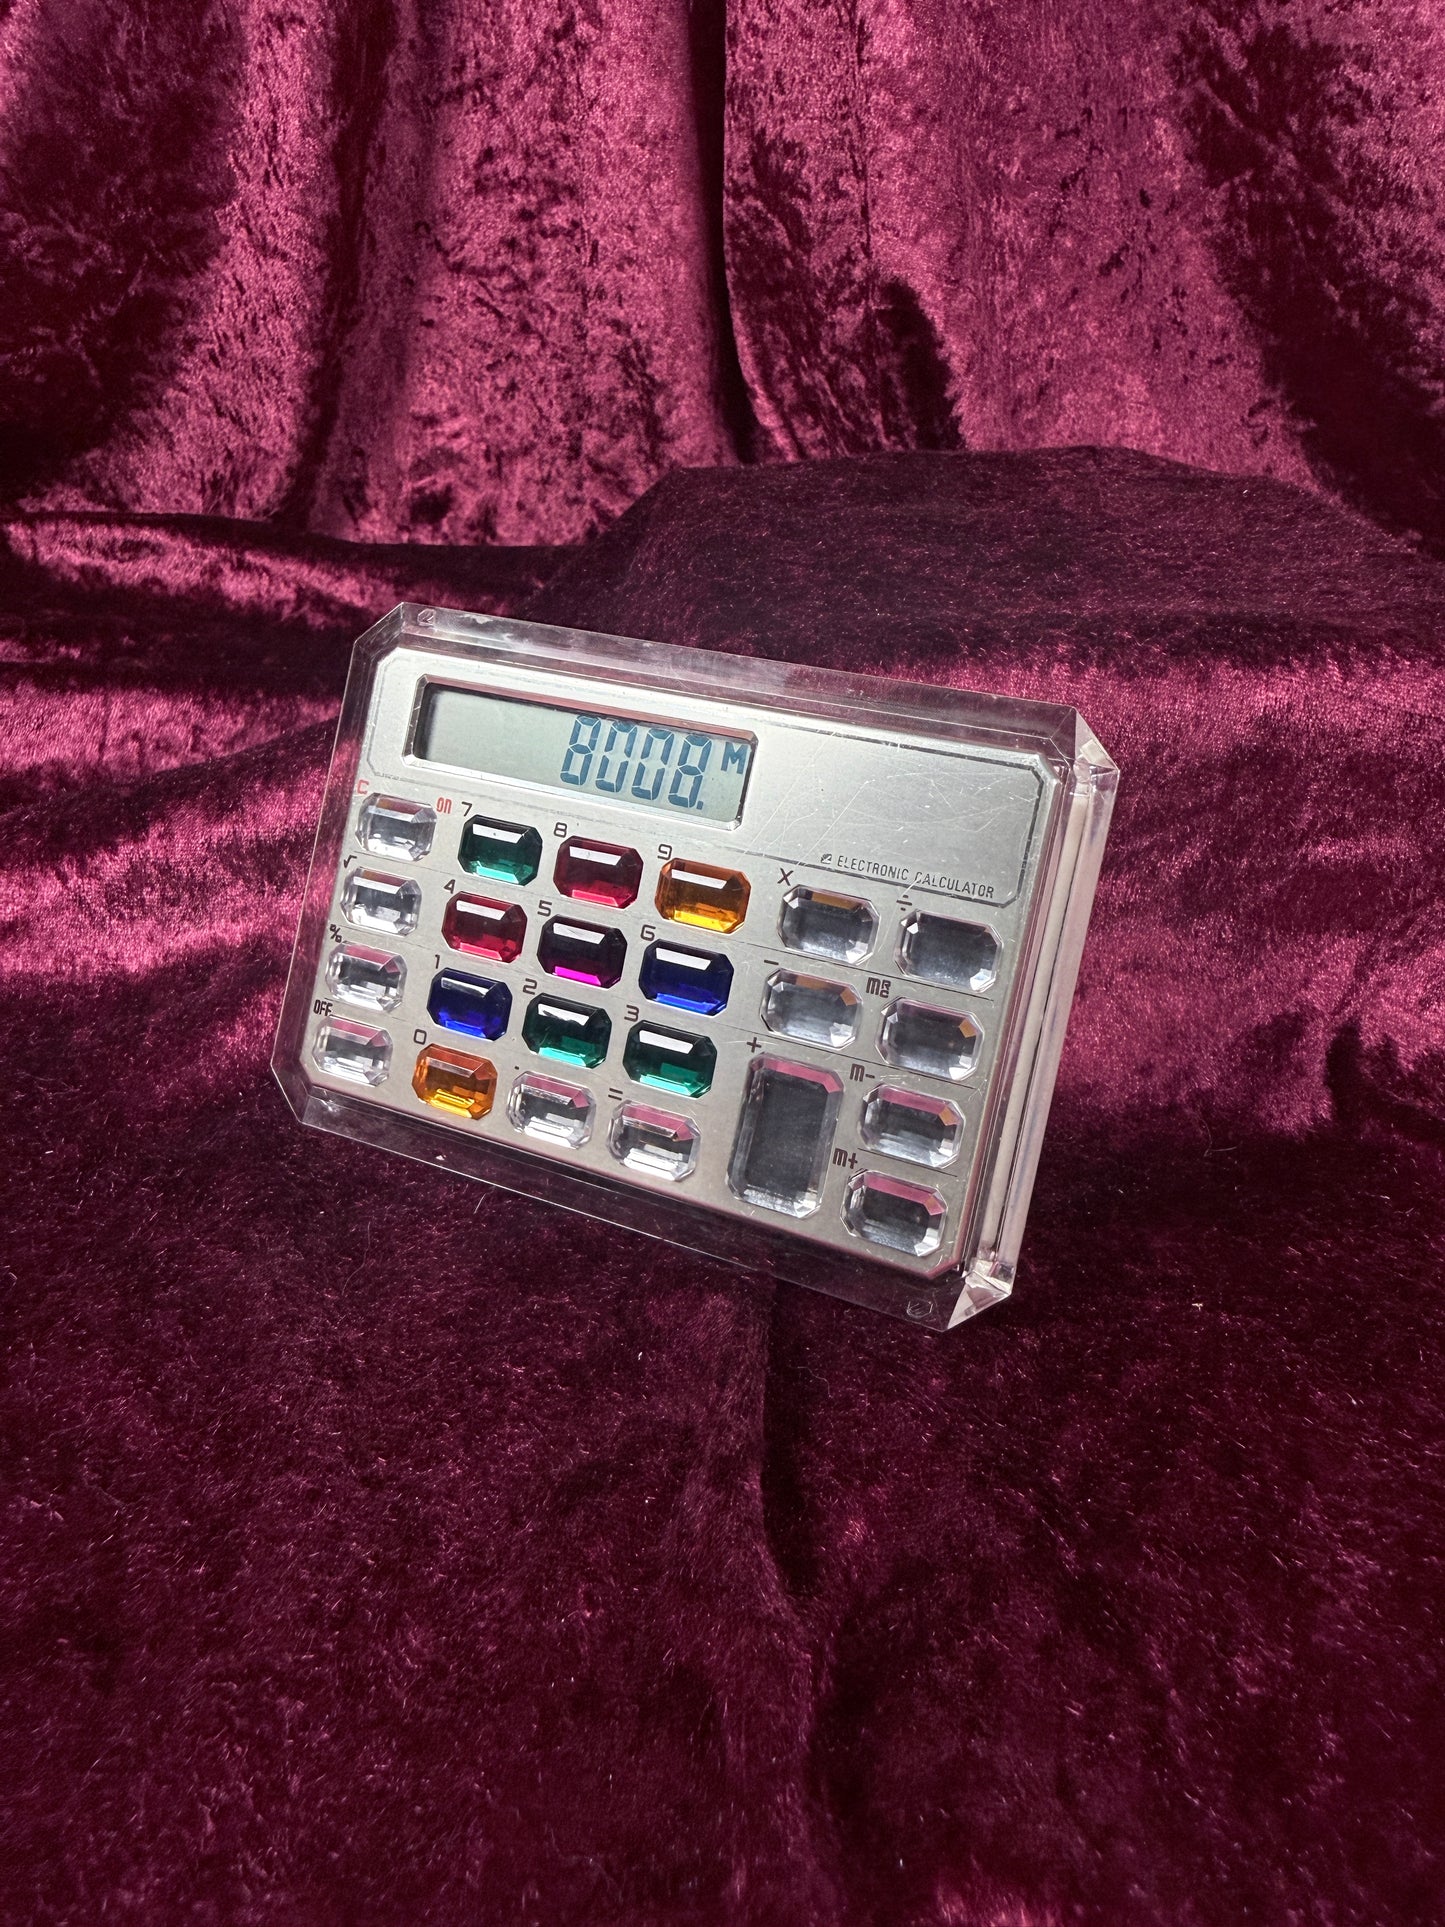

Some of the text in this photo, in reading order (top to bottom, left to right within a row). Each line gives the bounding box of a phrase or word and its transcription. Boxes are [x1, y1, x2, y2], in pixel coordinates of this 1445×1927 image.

[720, 741, 749, 774] M
[356, 779, 369, 795] C
[461, 801, 473, 816] 7
[553, 822, 567, 838] 8
[657, 843, 672, 860] 9
[837, 855, 994, 898] ELECTRONIC CALCULATOR
[443, 879, 456, 894] 4
[537, 900, 552, 917] 5
[330, 925, 342, 943] %
[640, 924, 655, 941] 6
[434, 955, 440, 969] 1
[522, 978, 537, 995] 2
[313, 1000, 332, 1016] OFF
[624, 1004, 640, 1022] 3
[413, 1029, 427, 1045] 0
[746, 1037, 762, 1053] +
[608, 1087, 623, 1101] =
